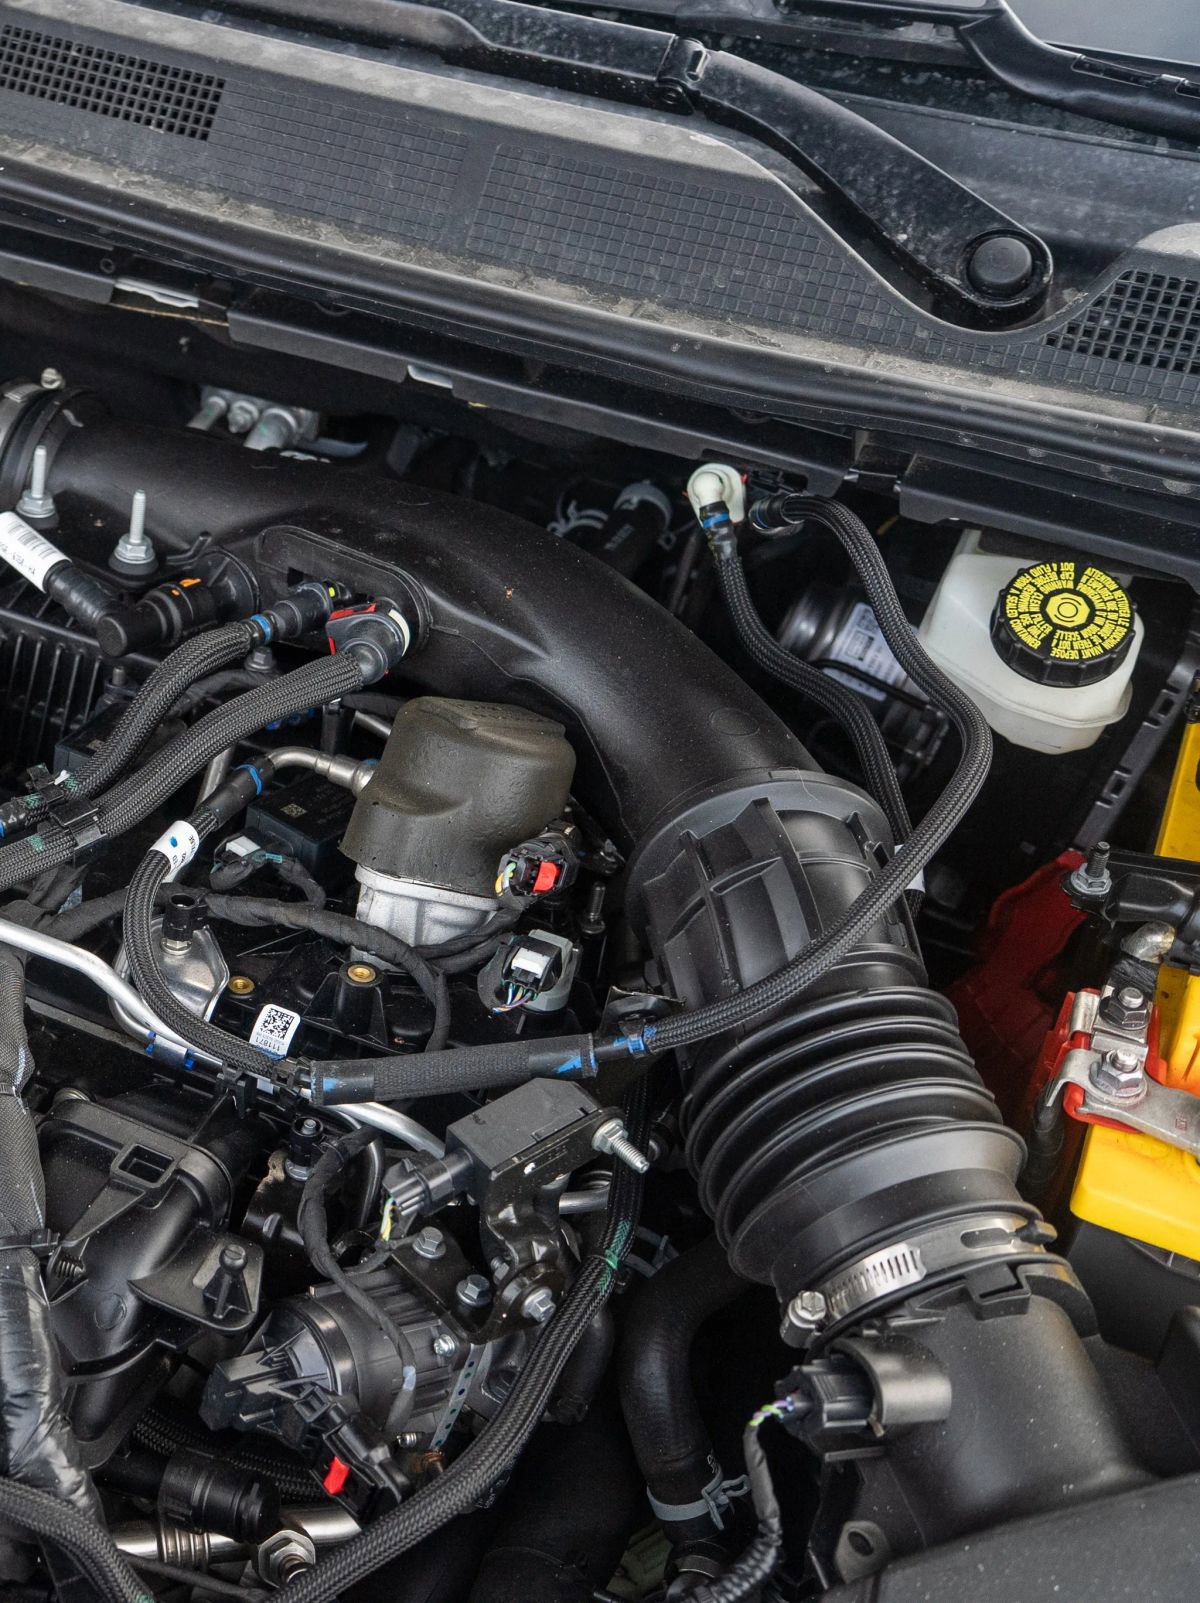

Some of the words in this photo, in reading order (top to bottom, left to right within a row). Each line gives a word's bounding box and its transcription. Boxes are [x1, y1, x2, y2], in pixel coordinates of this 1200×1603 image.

[1030, 564, 1051, 577] FLUID
[1052, 563, 1057, 571] 4
[1060, 562, 1074, 571] DOT
[1014, 573, 1032, 588] FROM
[1032, 572, 1058, 588] BEFORE
[1060, 572, 1074, 580] CAP
[1085, 567, 1119, 590] ATTENTION
[1040, 580, 1074, 594] WARNING
[1018, 584, 1036, 612] REMOVING
[1030, 592, 1044, 612] CLEAN
[1006, 595, 1018, 618] SEALED
[1106, 600, 1118, 612] QUE
[1019, 614, 1033, 626] USE
[1031, 614, 1053, 636] FILLER
[1118, 618, 1130, 626] LE
[1009, 618, 1041, 650] CONTAINER
[1027, 625, 1046, 640] ONLY
[1054, 630, 1080, 641] SCELLE
[1097, 619, 1116, 639] LIQUIDE
[1052, 638, 1058, 647] 4
[1058, 640, 1072, 649] DOT
[1072, 639, 1092, 649] FREIN
[1090, 634, 1102, 644] DE
[1101, 626, 1128, 650] BOUCHON
[1050, 648, 1079, 659] DEPOSE
[1081, 645, 1104, 658] AVANT
[255, 1036, 280, 1052] 111871
